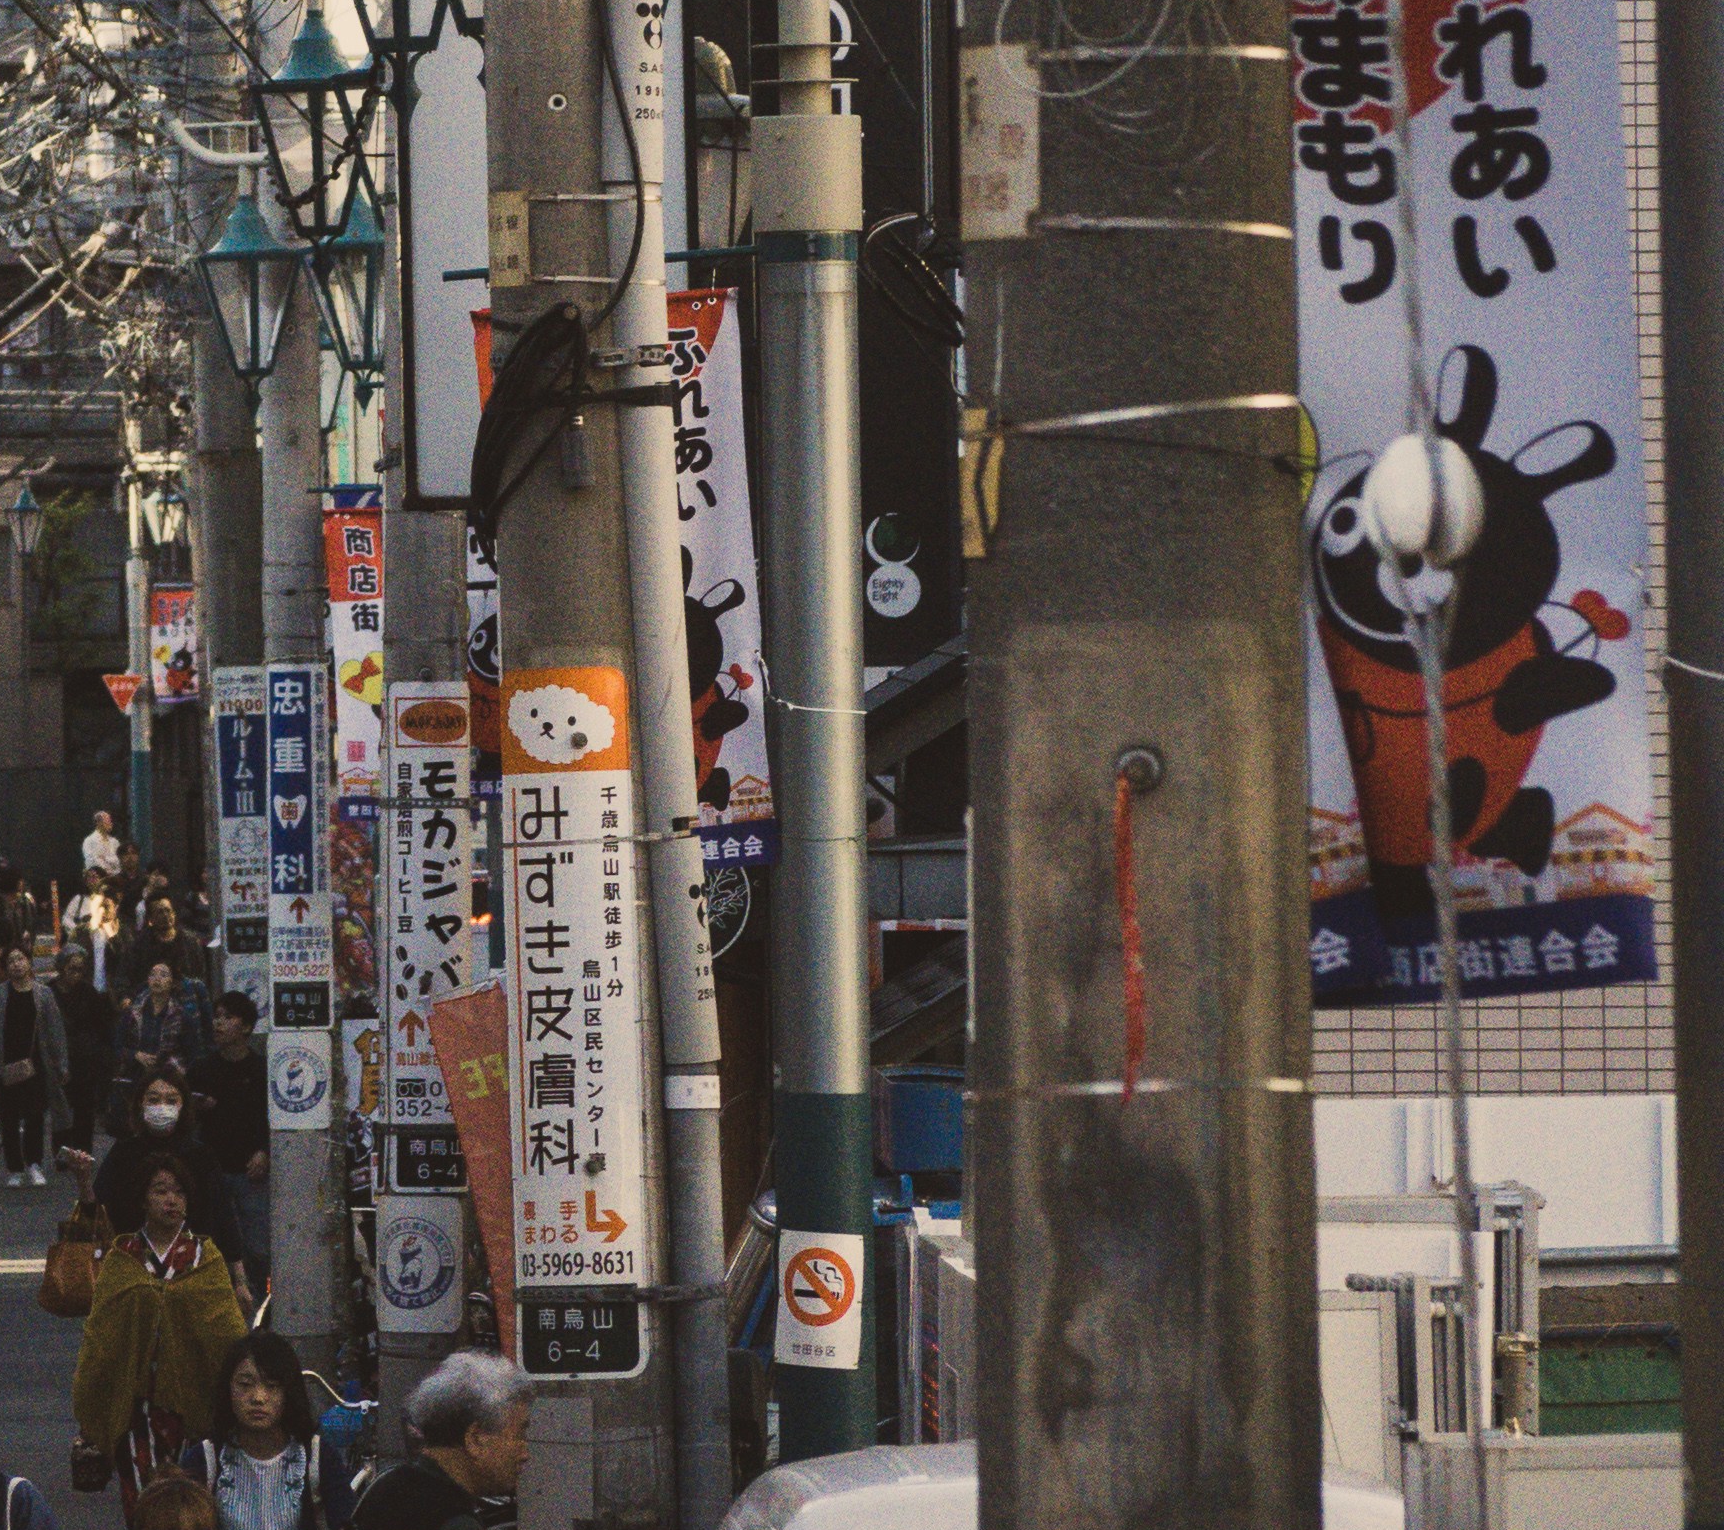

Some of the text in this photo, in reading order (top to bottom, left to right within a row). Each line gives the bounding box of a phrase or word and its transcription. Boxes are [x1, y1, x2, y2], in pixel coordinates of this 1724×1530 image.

[342, 525, 380, 633] 商店街
[273, 680, 308, 891] 忠重歯科
[419, 760, 463, 997] モカジャバ
[519, 785, 580, 1176] みずき皮膚科
[522, 1250, 635, 1278] 03-5969-8631
[523, 1224, 580, 1246] まわる
[548, 1340, 602, 1362] 6-4
